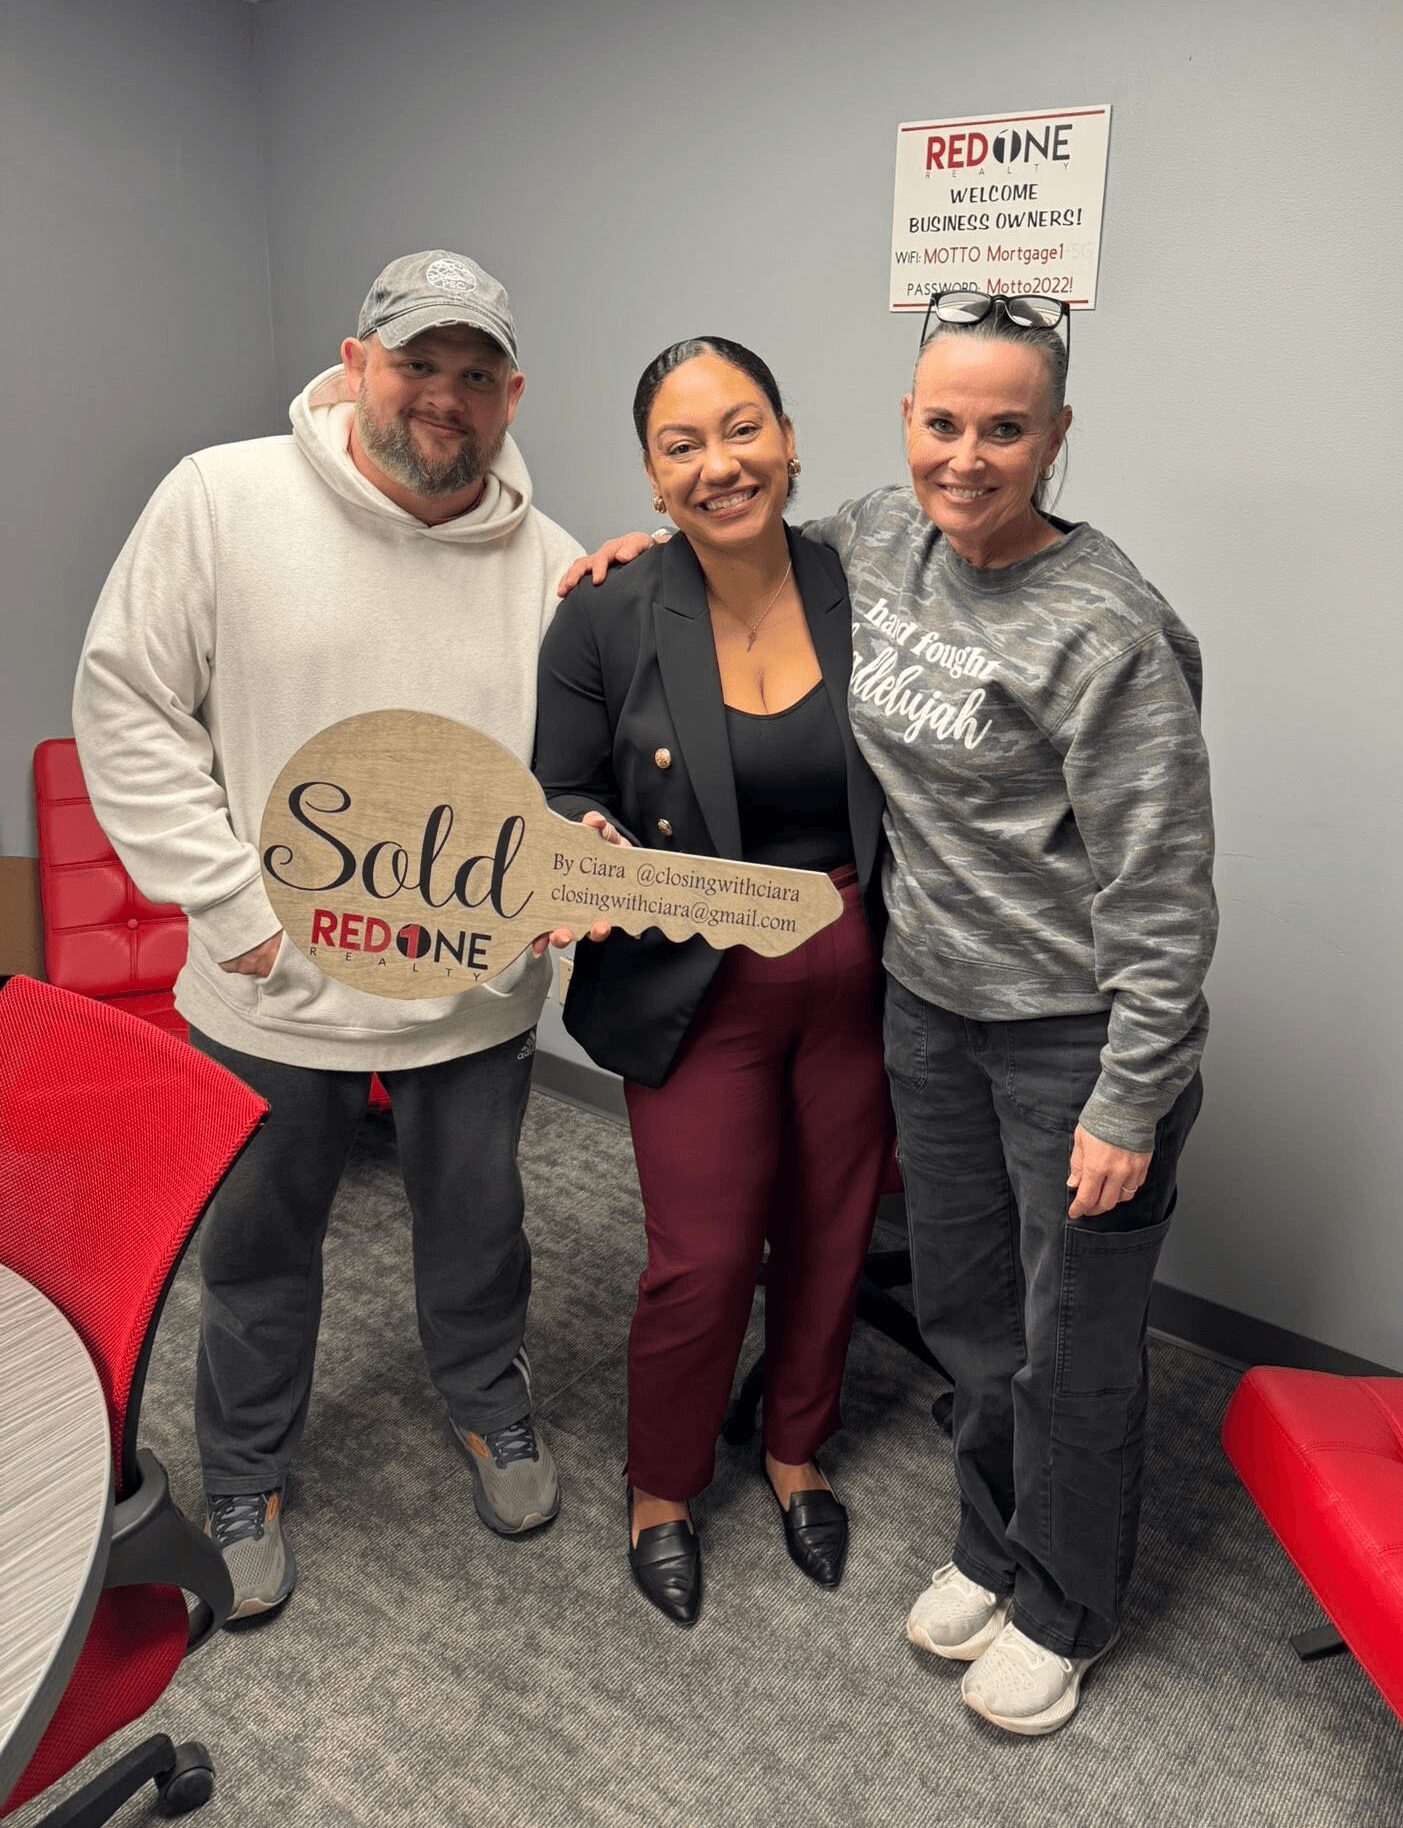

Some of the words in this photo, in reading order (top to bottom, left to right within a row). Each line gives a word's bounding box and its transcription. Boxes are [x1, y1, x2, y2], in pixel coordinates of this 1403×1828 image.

[925, 163, 1068, 179] REALTY
[950, 184, 1039, 204] WELCOME
[909, 213, 990, 233] BUSINESS
[996, 208, 1082, 230] OWNERS!
[923, 246, 981, 264] MOTTO
[987, 276, 1073, 295] Motto2022!
[864, 598, 918, 646] had
[910, 631, 1002, 680] fought
[850, 646, 992, 749] llelujah
[263, 781, 534, 919] Sold
[553, 853, 574, 875] By
[579, 856, 626, 879] Ciara
[636, 863, 800, 902] @closingwithciara
[550, 885, 797, 932] closingwithciara@gmail.com
[309, 947, 482, 982] REALTY
